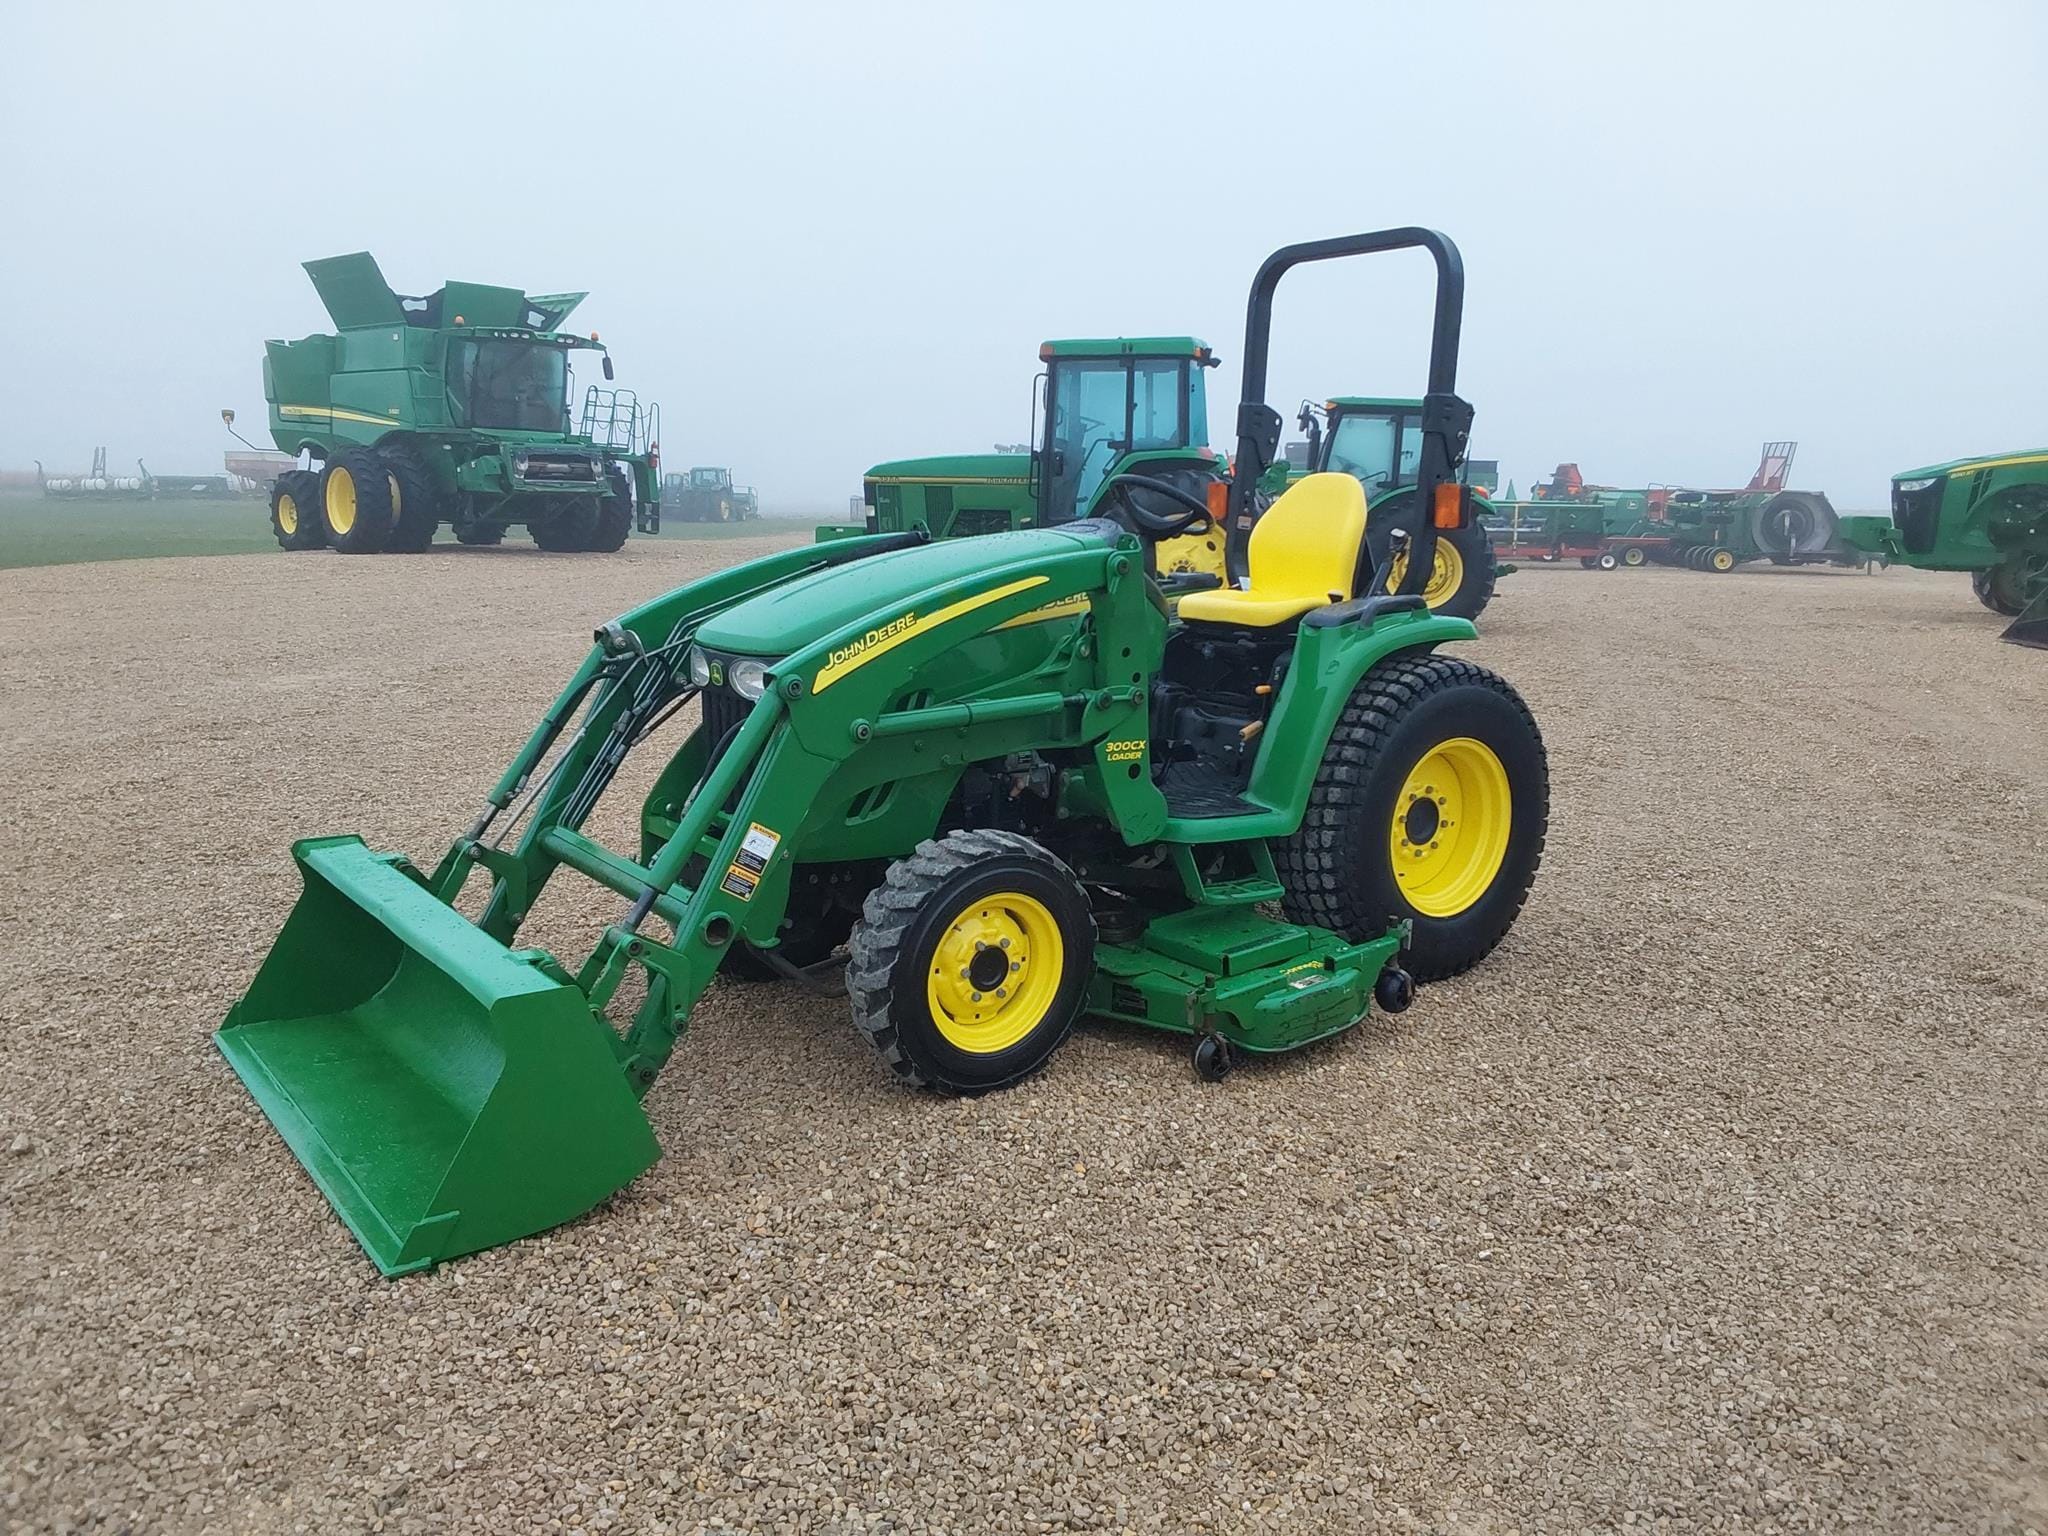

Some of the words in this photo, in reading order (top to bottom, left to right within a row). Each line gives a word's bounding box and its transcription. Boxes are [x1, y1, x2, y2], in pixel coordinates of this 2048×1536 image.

[824, 638, 865, 671] JOHN
[865, 611, 917, 649] DEERE
[1105, 740, 1146, 752] 300CX
[1107, 751, 1142, 761] LOADER
